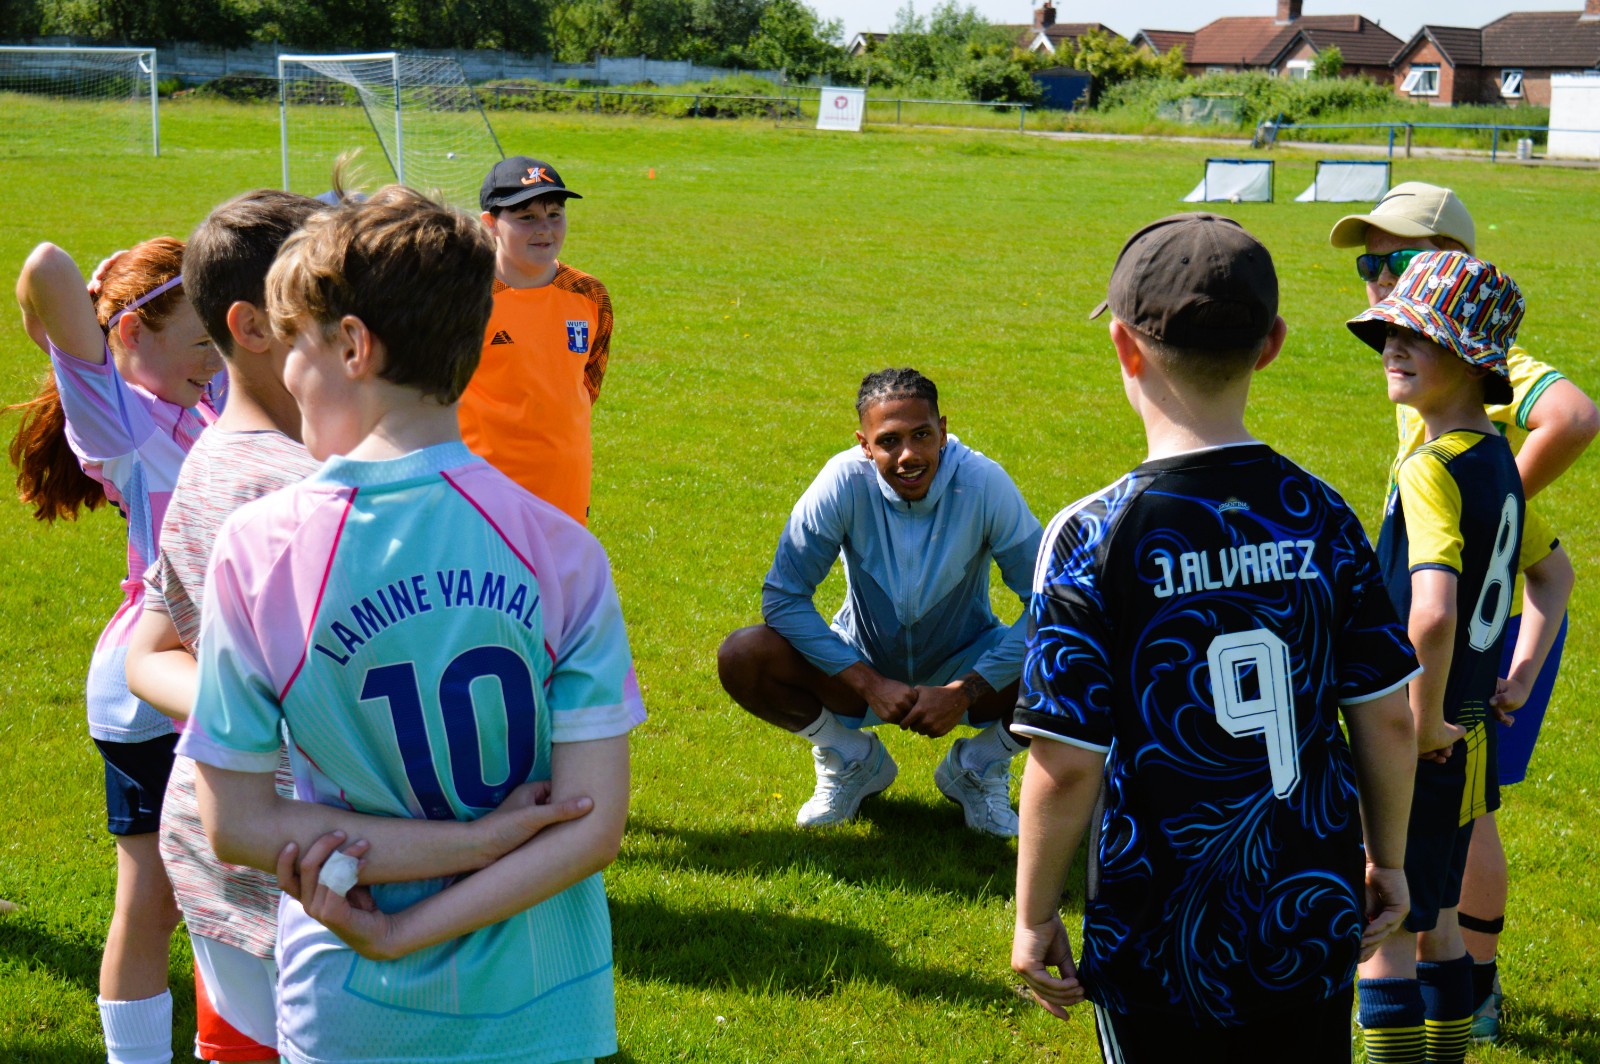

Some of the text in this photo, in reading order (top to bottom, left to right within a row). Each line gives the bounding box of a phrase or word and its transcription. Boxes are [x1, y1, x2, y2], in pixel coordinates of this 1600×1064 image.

[314, 569, 541, 667] LAMINE YAMAL
[1154, 540, 1319, 598] J.ALVAREZ
[1468, 493, 1518, 653] 8
[358, 645, 538, 820] 10
[1206, 628, 1301, 800] 9
